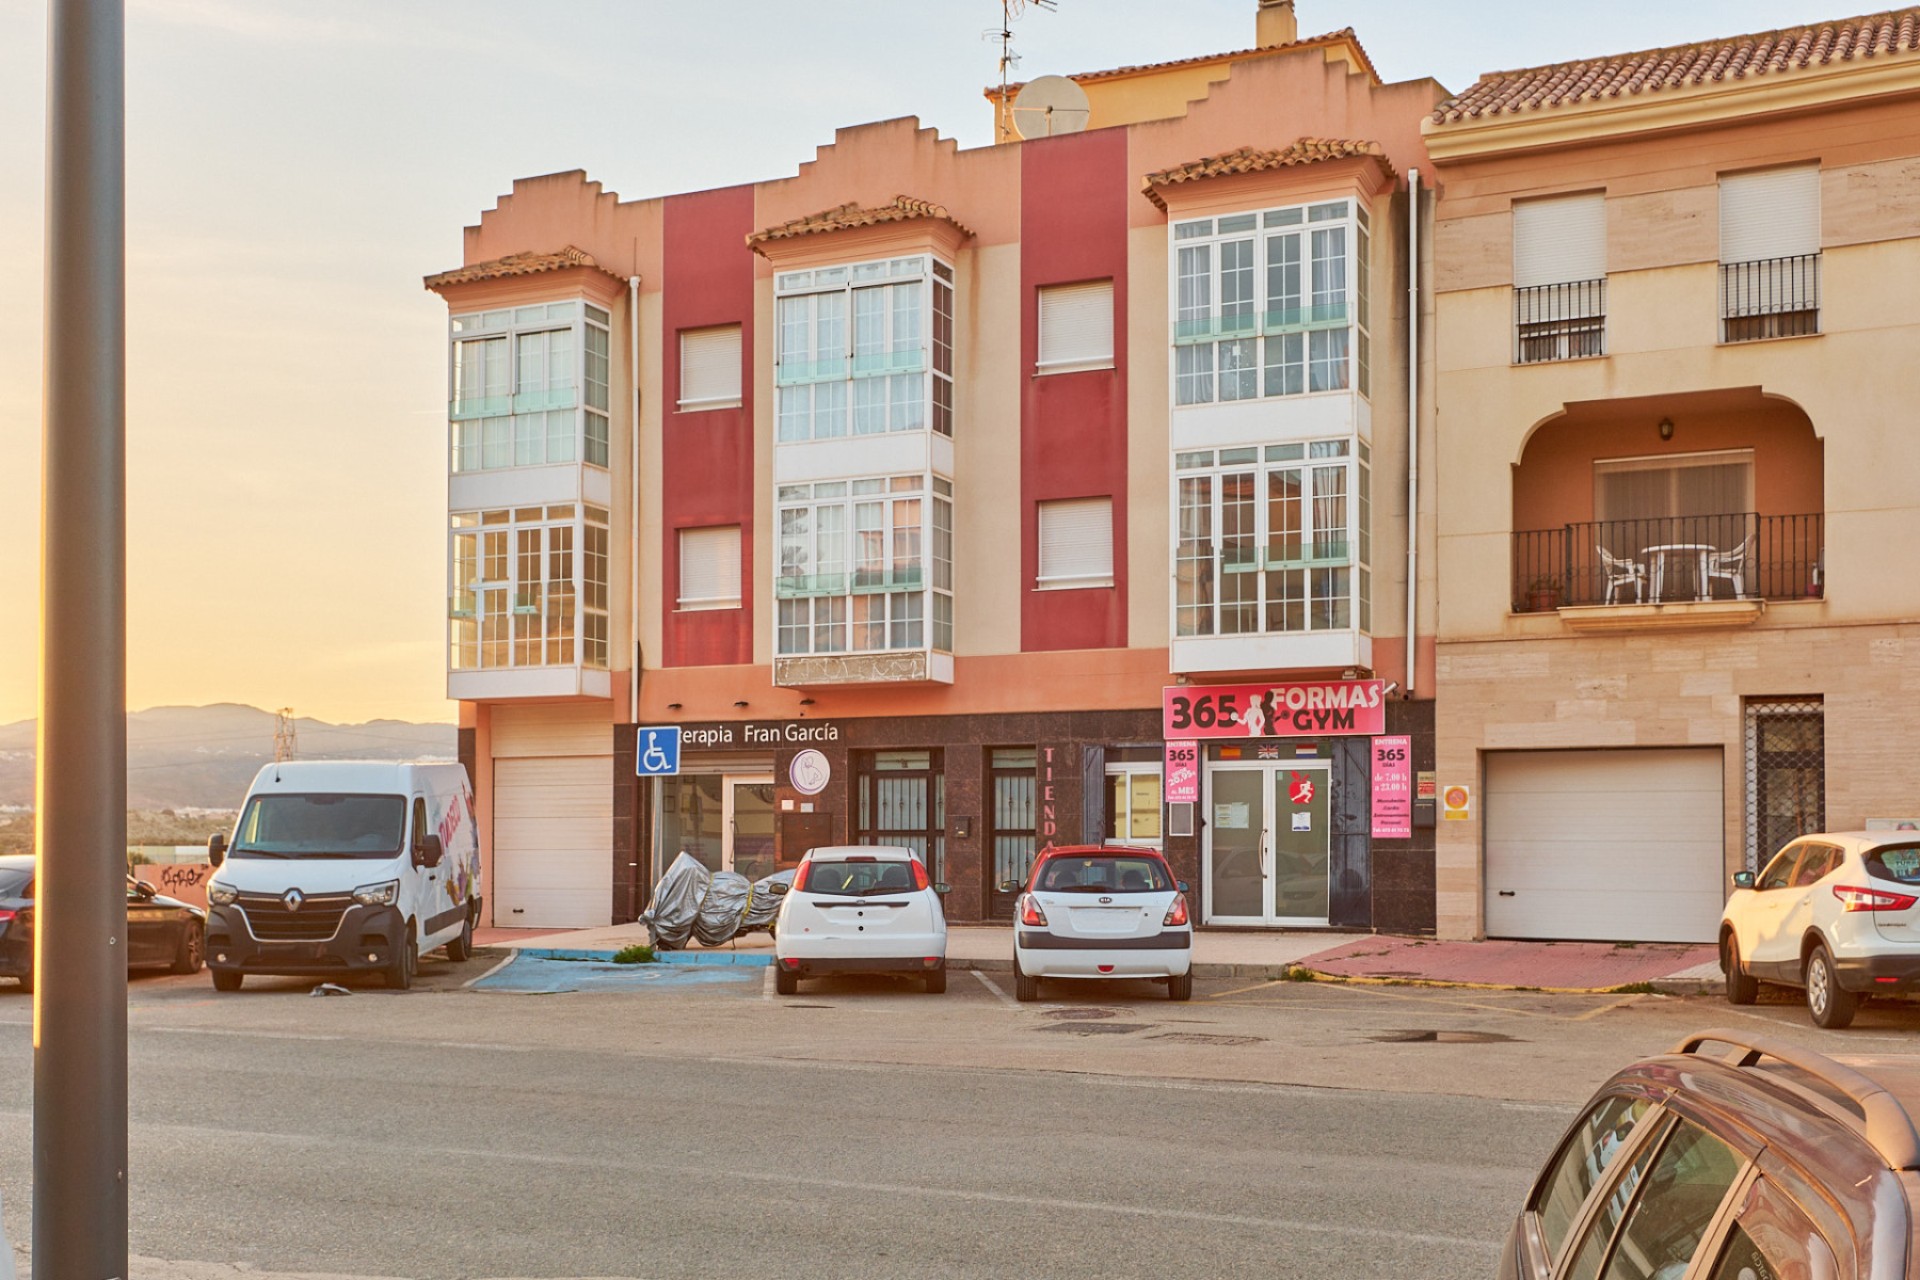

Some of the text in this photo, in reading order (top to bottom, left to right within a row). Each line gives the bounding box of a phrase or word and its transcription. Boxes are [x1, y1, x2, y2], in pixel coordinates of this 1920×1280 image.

[1271, 684, 1380, 711] FORMAS
[1171, 694, 1241, 729] 365
[1293, 708, 1355, 731] GYM
[744, 725, 780, 742] Fran
[785, 723, 838, 741] García
[1169, 750, 1195, 761] 365
[1377, 749, 1405, 761] 365
